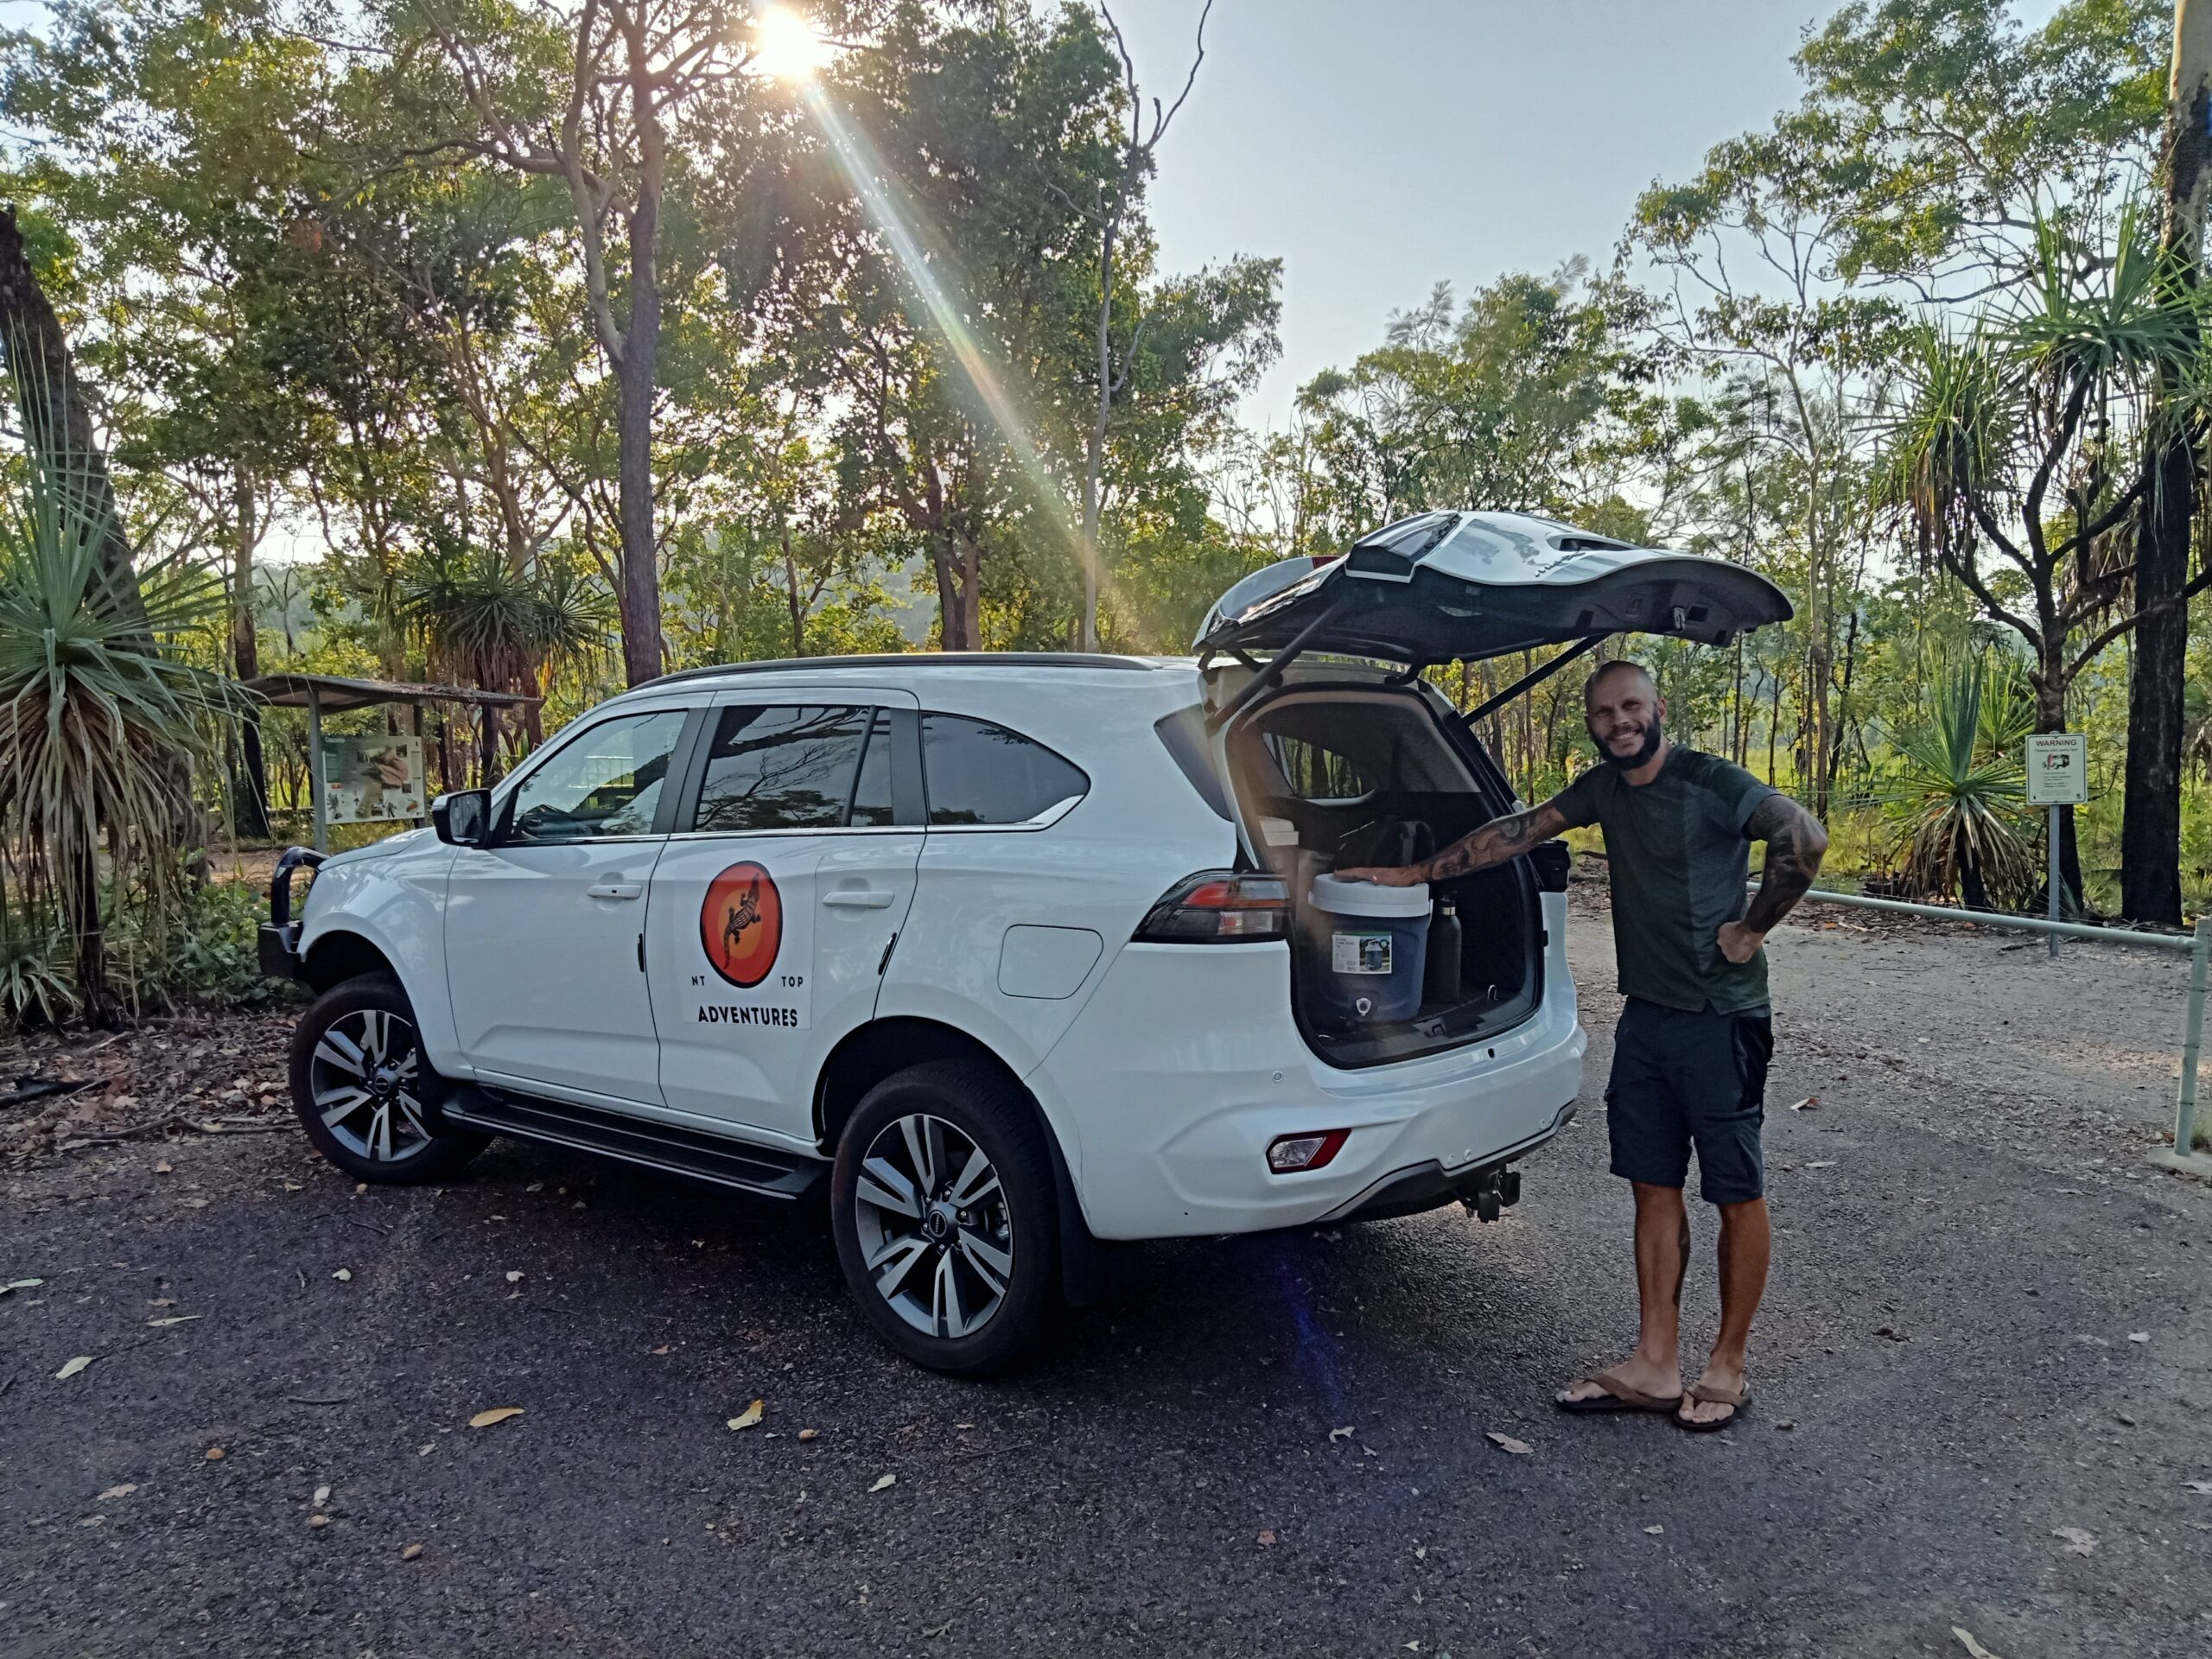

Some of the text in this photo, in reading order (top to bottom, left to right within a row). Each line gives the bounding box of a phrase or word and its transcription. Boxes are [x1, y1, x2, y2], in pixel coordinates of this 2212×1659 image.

[691, 976, 804, 987] NT TOP
[698, 1006, 798, 1027] ADVENTURES
